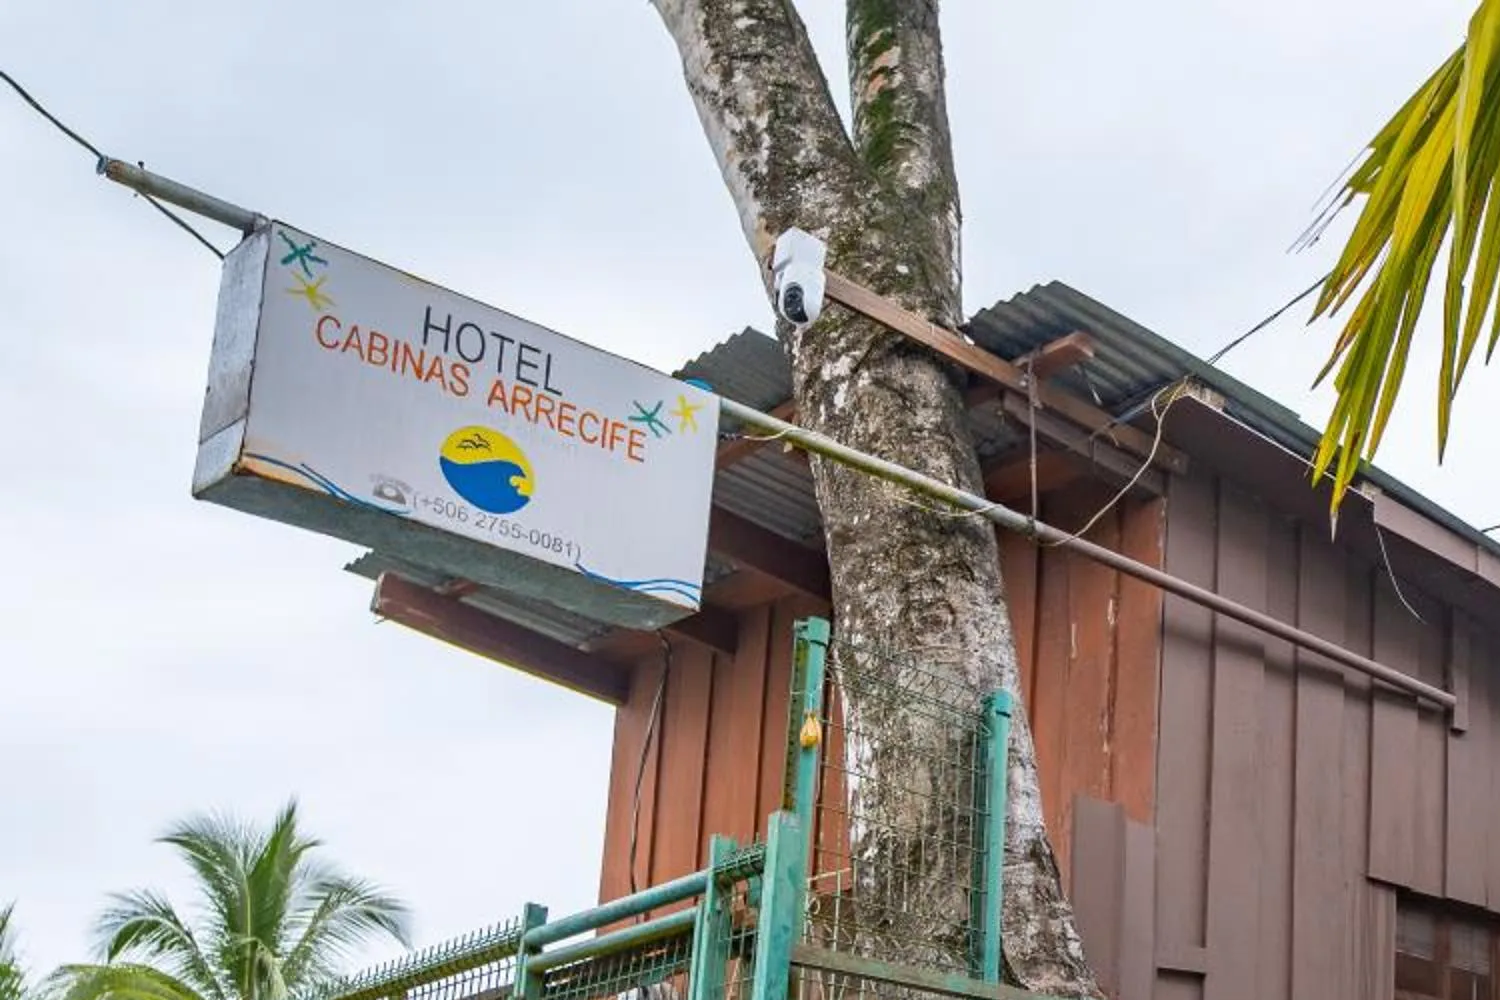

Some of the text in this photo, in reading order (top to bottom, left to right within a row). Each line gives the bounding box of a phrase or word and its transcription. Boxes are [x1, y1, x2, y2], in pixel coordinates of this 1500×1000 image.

[315, 314, 648, 464] CABINAS ARRECIFE
[422, 304, 563, 397] HOTEL
[412, 493, 582, 564] (+506 2755-0081)
